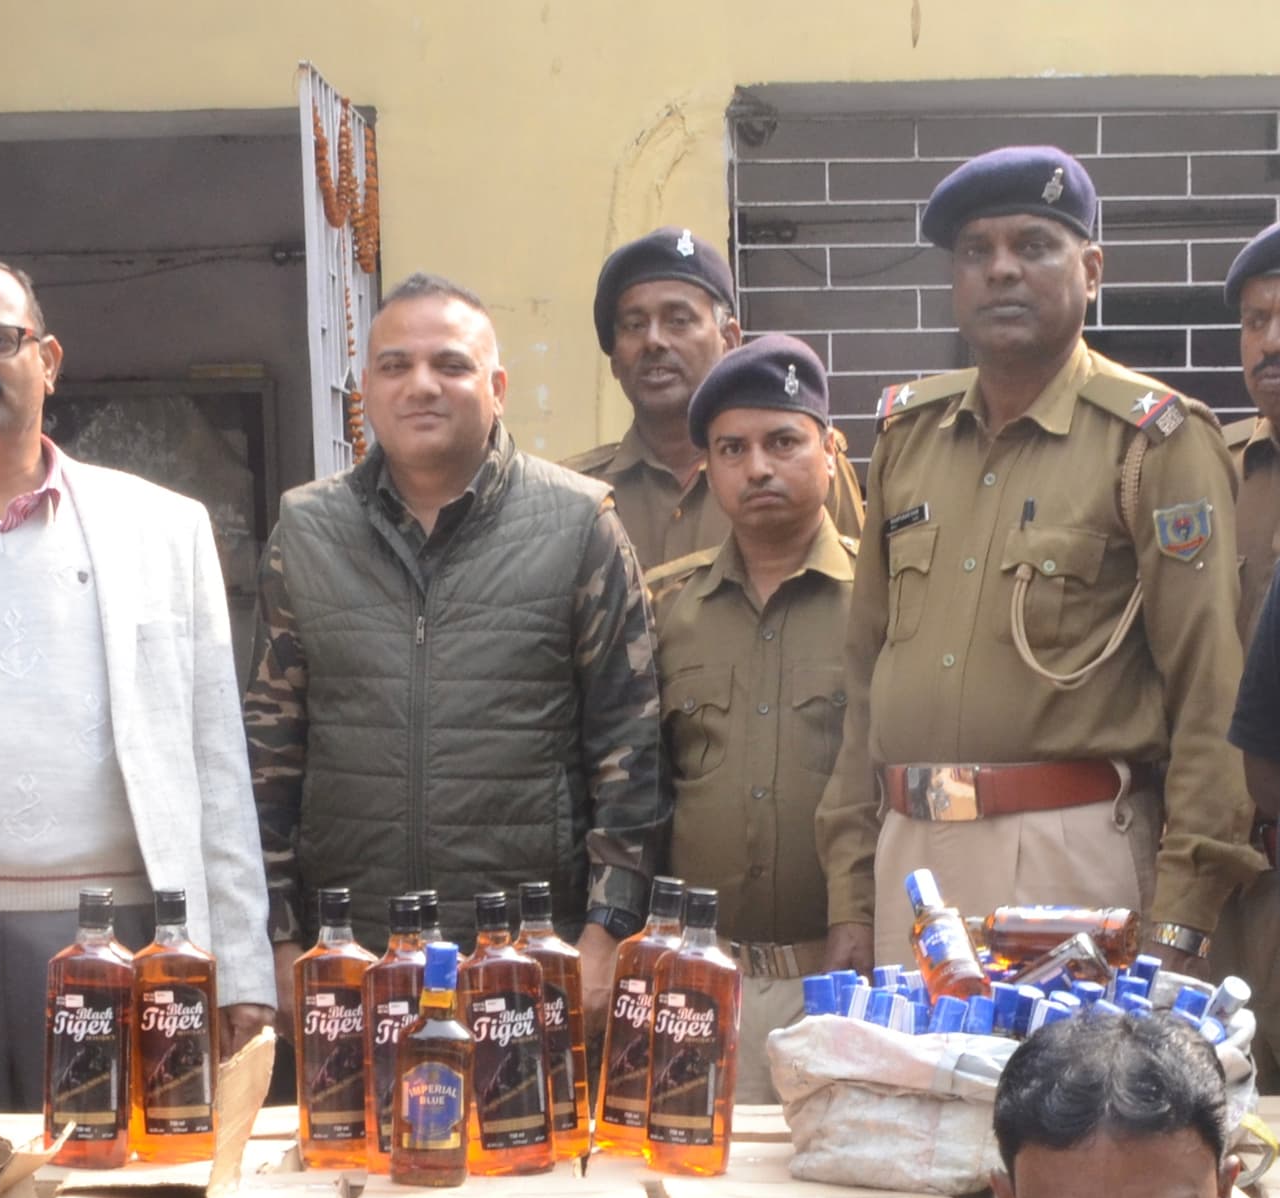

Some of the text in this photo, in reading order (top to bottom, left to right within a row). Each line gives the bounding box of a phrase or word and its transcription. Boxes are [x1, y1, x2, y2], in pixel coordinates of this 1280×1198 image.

[75, 1007, 115, 1020] Black
[166, 1001, 204, 1016] Black
[499, 1006, 535, 1024] Black
[676, 1007, 715, 1022] Black
[53, 1010, 113, 1043] Tiger
[141, 1006, 203, 1038] Tiger
[304, 1010, 363, 1042] Tiger
[655, 1009, 713, 1043] Tiger
[473, 1016, 535, 1047] Tiger
[408, 1083, 457, 1098] IMPERIAL
[419, 1095, 445, 1106] BLUE
